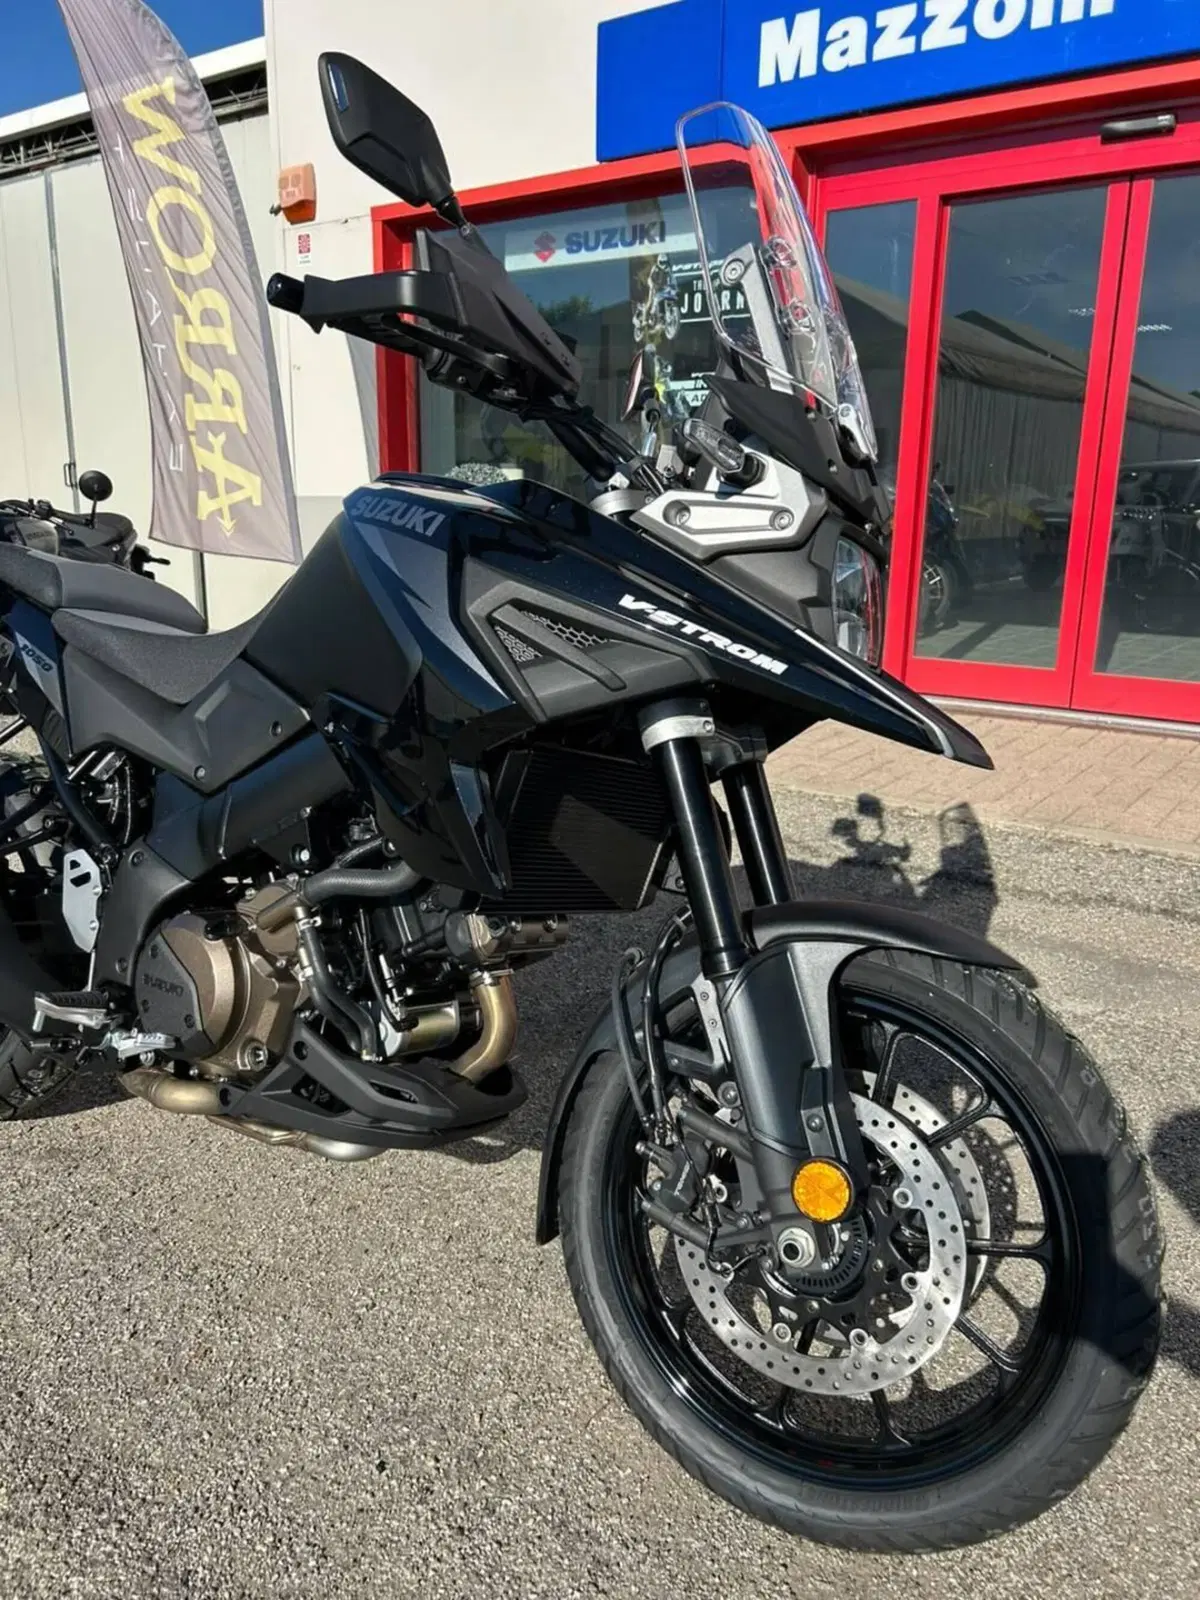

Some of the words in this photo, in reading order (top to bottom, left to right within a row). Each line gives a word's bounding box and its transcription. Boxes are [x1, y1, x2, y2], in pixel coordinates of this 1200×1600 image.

[758, 0, 1115, 88] Mazzon
[564, 220, 666, 254] SUZUKI
[350, 495, 447, 537] SUZUKI
[618, 593, 790, 675] V-STROM
[20, 643, 53, 672] 1050
